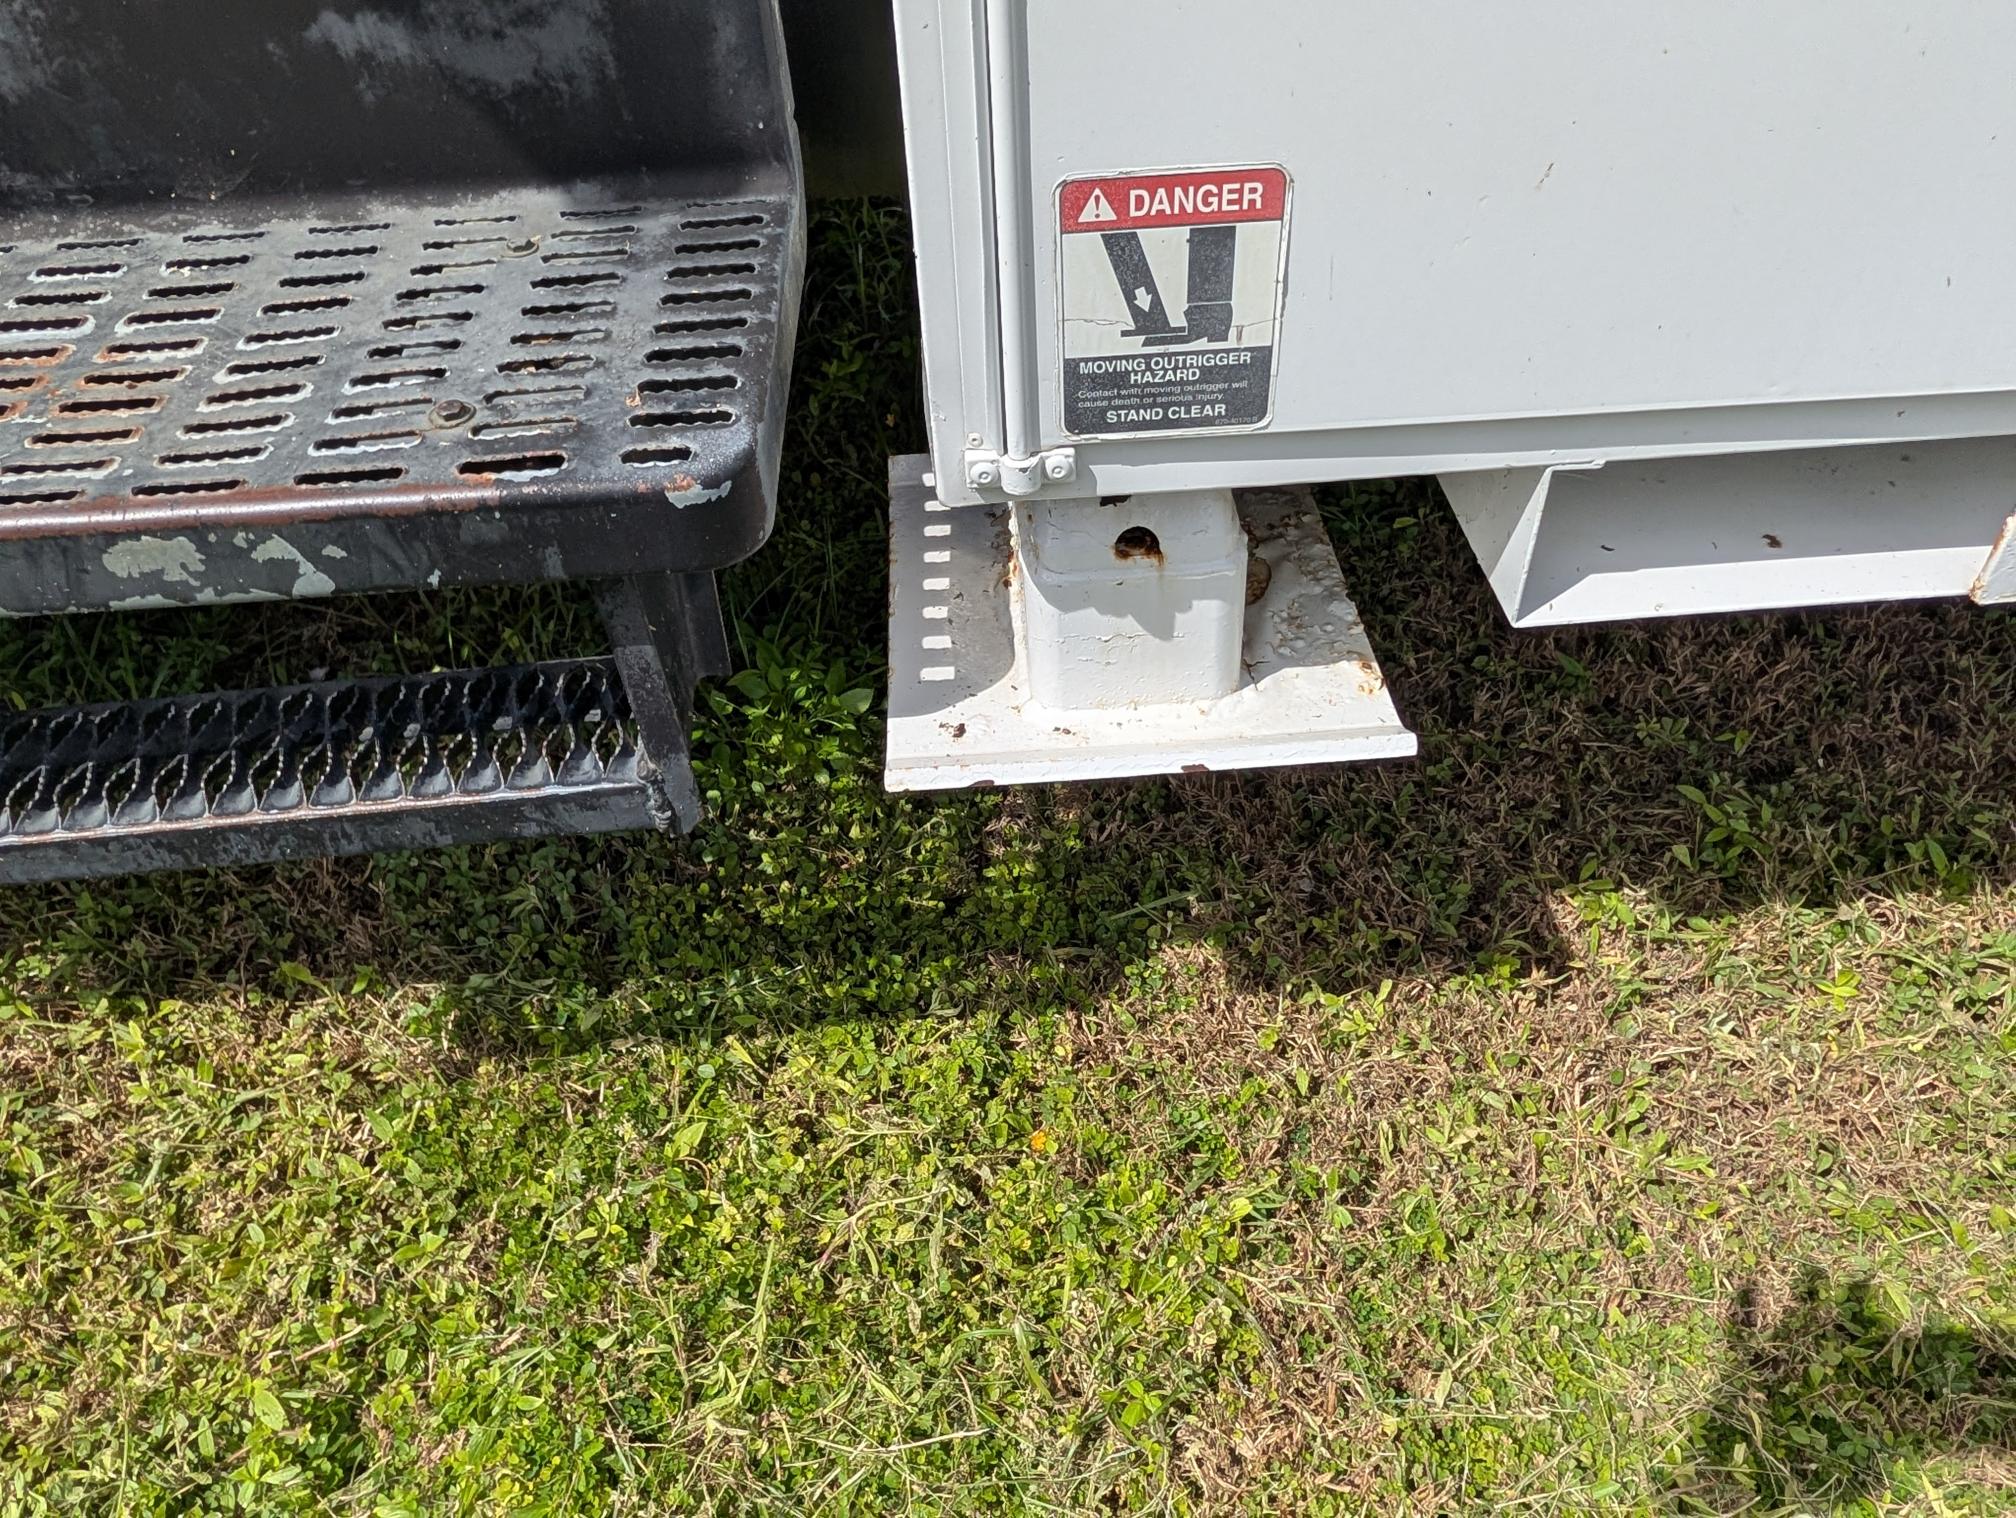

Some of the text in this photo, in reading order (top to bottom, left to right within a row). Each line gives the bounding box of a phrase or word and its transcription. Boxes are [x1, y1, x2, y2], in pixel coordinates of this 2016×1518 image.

[1129, 182, 1263, 218] DANGER
[1079, 352, 1251, 374] MOVING OUTRIGGER
[1130, 368, 1200, 384] HAZARD
[1078, 380, 1248, 398] Contact with moving outrigger will
[1078, 400, 1109, 408] cause
[1111, 398, 1140, 406] death
[1155, 395, 1193, 403] serious
[1106, 404, 1226, 423] STAND CLEAR
